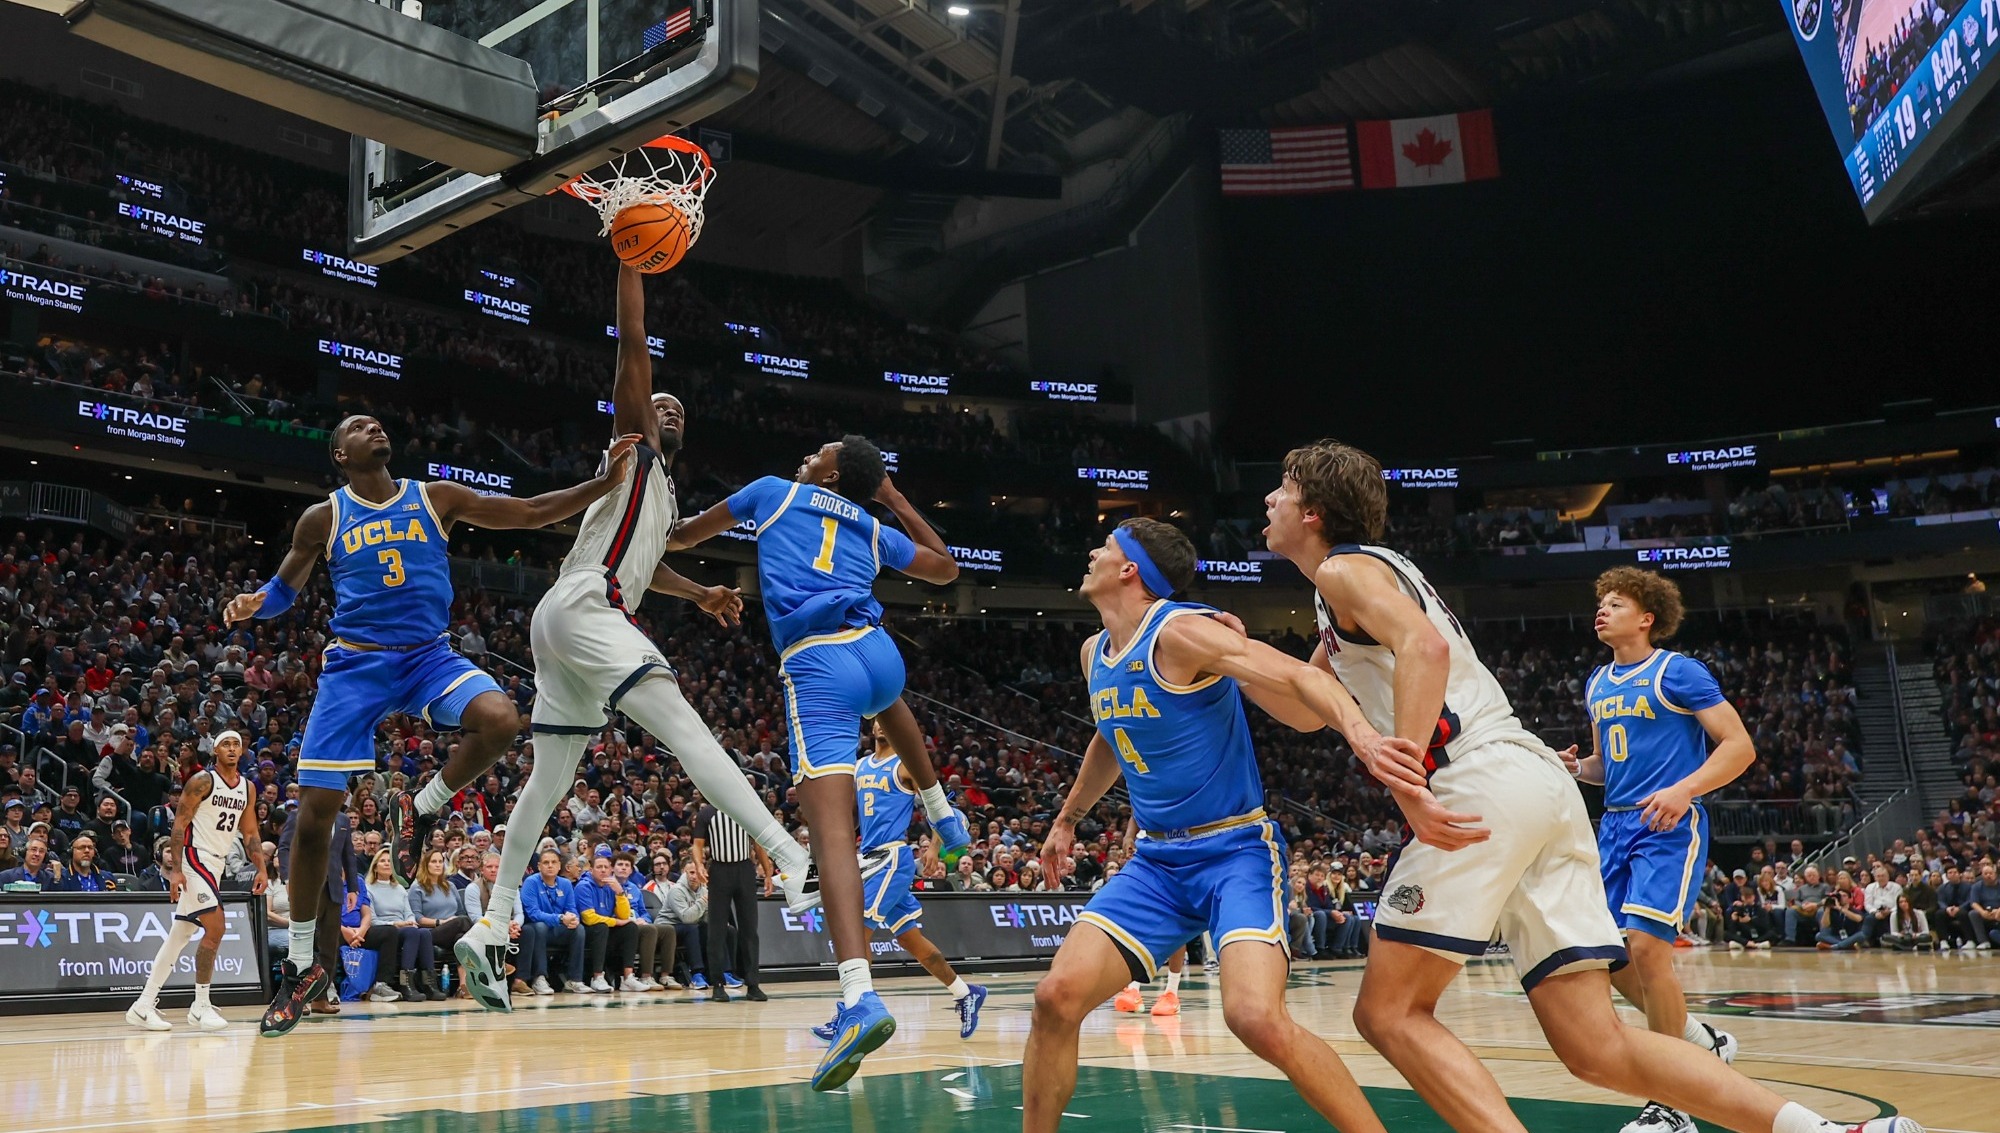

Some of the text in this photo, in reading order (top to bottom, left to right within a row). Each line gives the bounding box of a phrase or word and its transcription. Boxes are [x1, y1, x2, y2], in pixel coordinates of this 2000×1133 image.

[1931, 29, 1962, 92] 8:02
[1894, 94, 1916, 150] 19
[180, 232, 203, 245] Stanley
[322, 267, 377, 288] from Morgan Stanley
[5, 288, 82, 313] from Morgan Stanley
[481, 306, 530, 325] from Morgan Stanley
[340, 360, 401, 381] from Morgan Stanley
[761, 366, 808, 379] from Morgan Stanley
[911, 386, 929, 394] Morgan
[929, 387, 948, 395] Stanley
[1061, 393, 1079, 401] Morgan
[1079, 394, 1097, 402] Stanley
[106, 424, 185, 448] from Morgan Stanley
[1708, 461, 1732, 470] Morgan
[1732, 459, 1757, 468] Stanley
[1110, 481, 1130, 489] Morgan
[1130, 482, 1149, 490] Stanley
[1416, 481, 1437, 489] Morgan
[1437, 481, 1459, 489] Stanley
[809, 492, 860, 522] BOOKER
[341, 518, 428, 554] UCLA
[812, 516, 839, 574] 1
[948, 546, 1002, 562] TRADE
[377, 548, 406, 588] 3
[964, 561, 983, 570] Morgan
[983, 563, 1002, 572] Stanley
[1196, 559, 1263, 573] TRADE
[1663, 560, 1731, 570] from Morgan Stanley
[1207, 573, 1262, 583] from Morgan Stanley
[1090, 686, 1162, 725] UCLA
[1590, 694, 1655, 725] UCLA
[1114, 727, 1150, 774] 4
[1608, 723, 1629, 762] 0
[856, 774, 891, 793] UCLA
[863, 791, 875, 817] 2
[215, 811, 236, 832] 23
[870, 939, 892, 956] rgan
[1031, 934, 1053, 947] from
[58, 955, 243, 978] from Morg Stley
